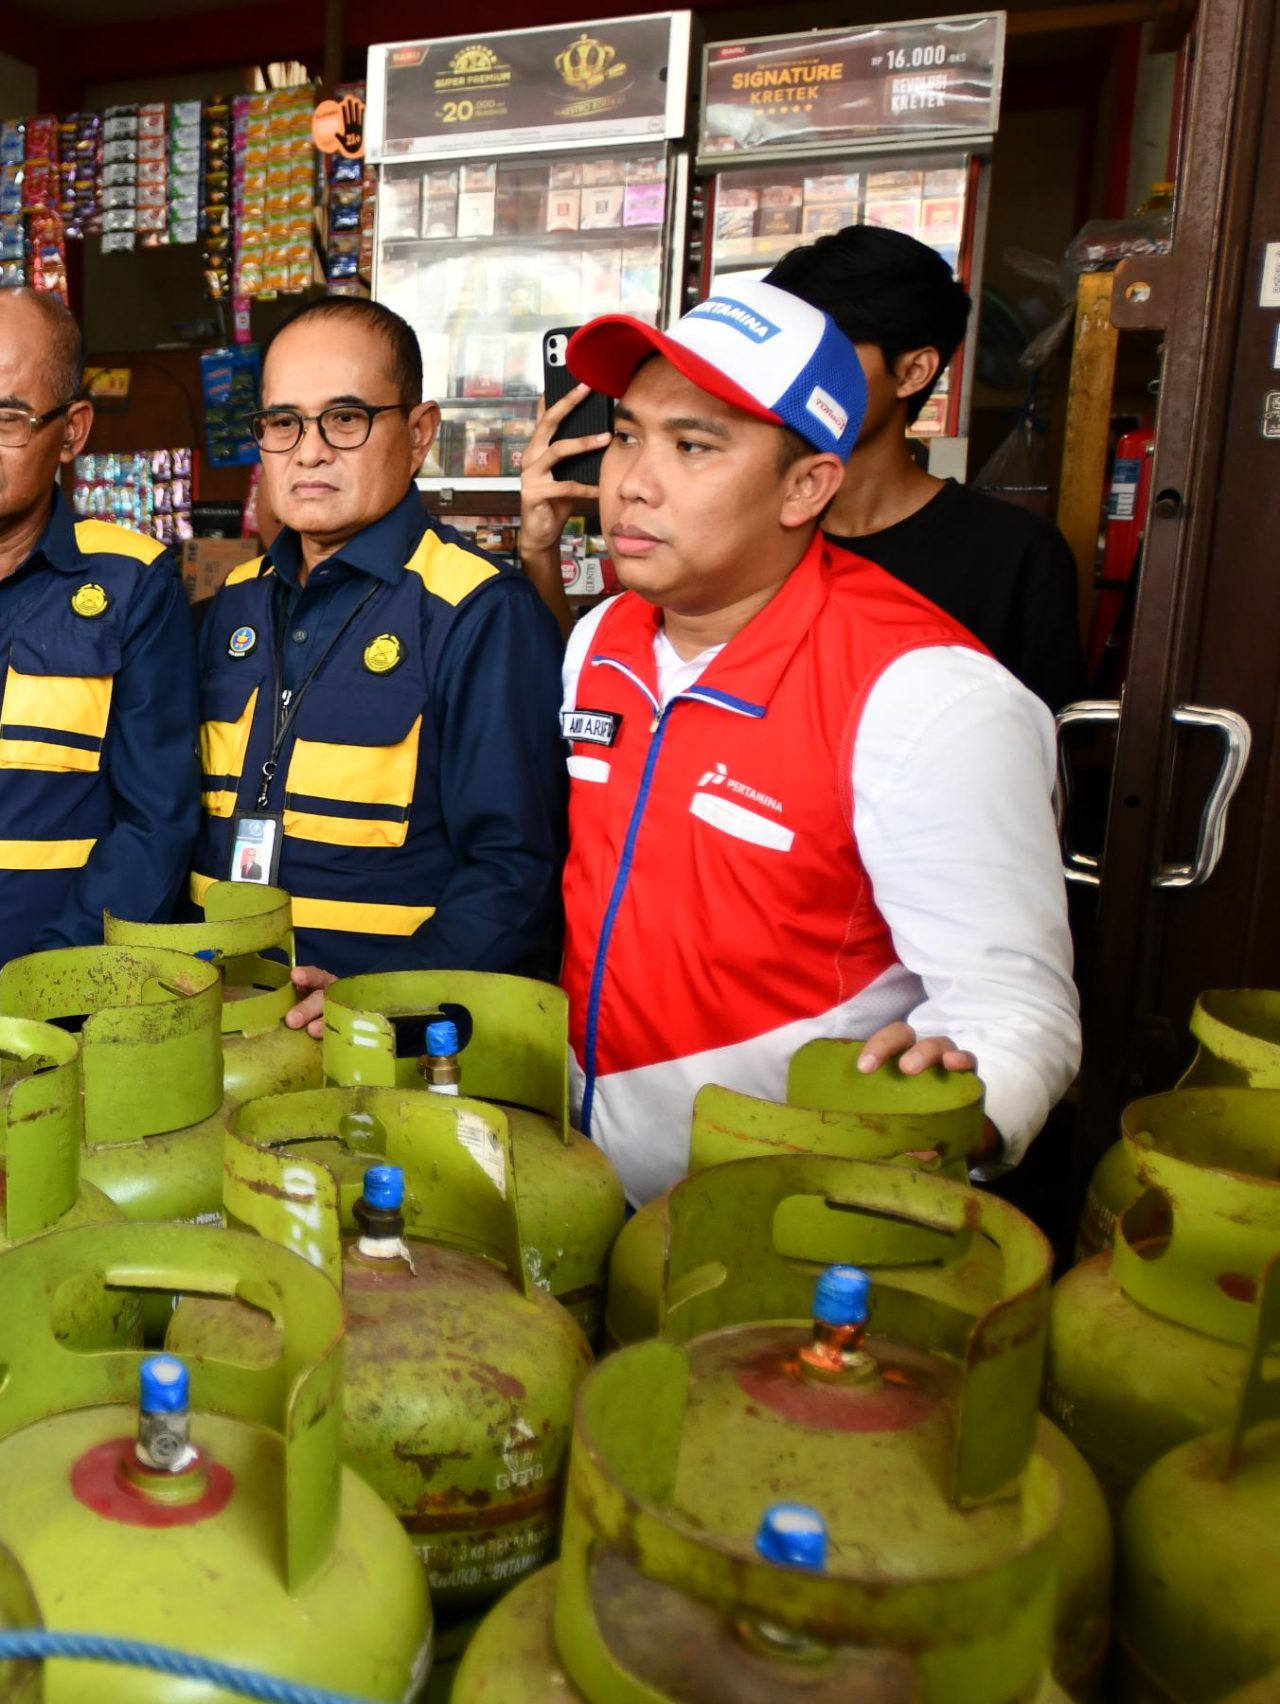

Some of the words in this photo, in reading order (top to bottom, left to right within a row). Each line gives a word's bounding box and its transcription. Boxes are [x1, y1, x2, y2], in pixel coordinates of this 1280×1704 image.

[886, 45, 946, 70] 16.000
[434, 76, 466, 88] SUPER
[466, 71, 511, 85] PREMIUM
[731, 63, 843, 90] SIGNATURE
[750, 85, 819, 104] KRETEK
[891, 91, 945, 114] KRETEK
[442, 100, 474, 123] 20
[727, 778, 783, 813] PERTAMINA
